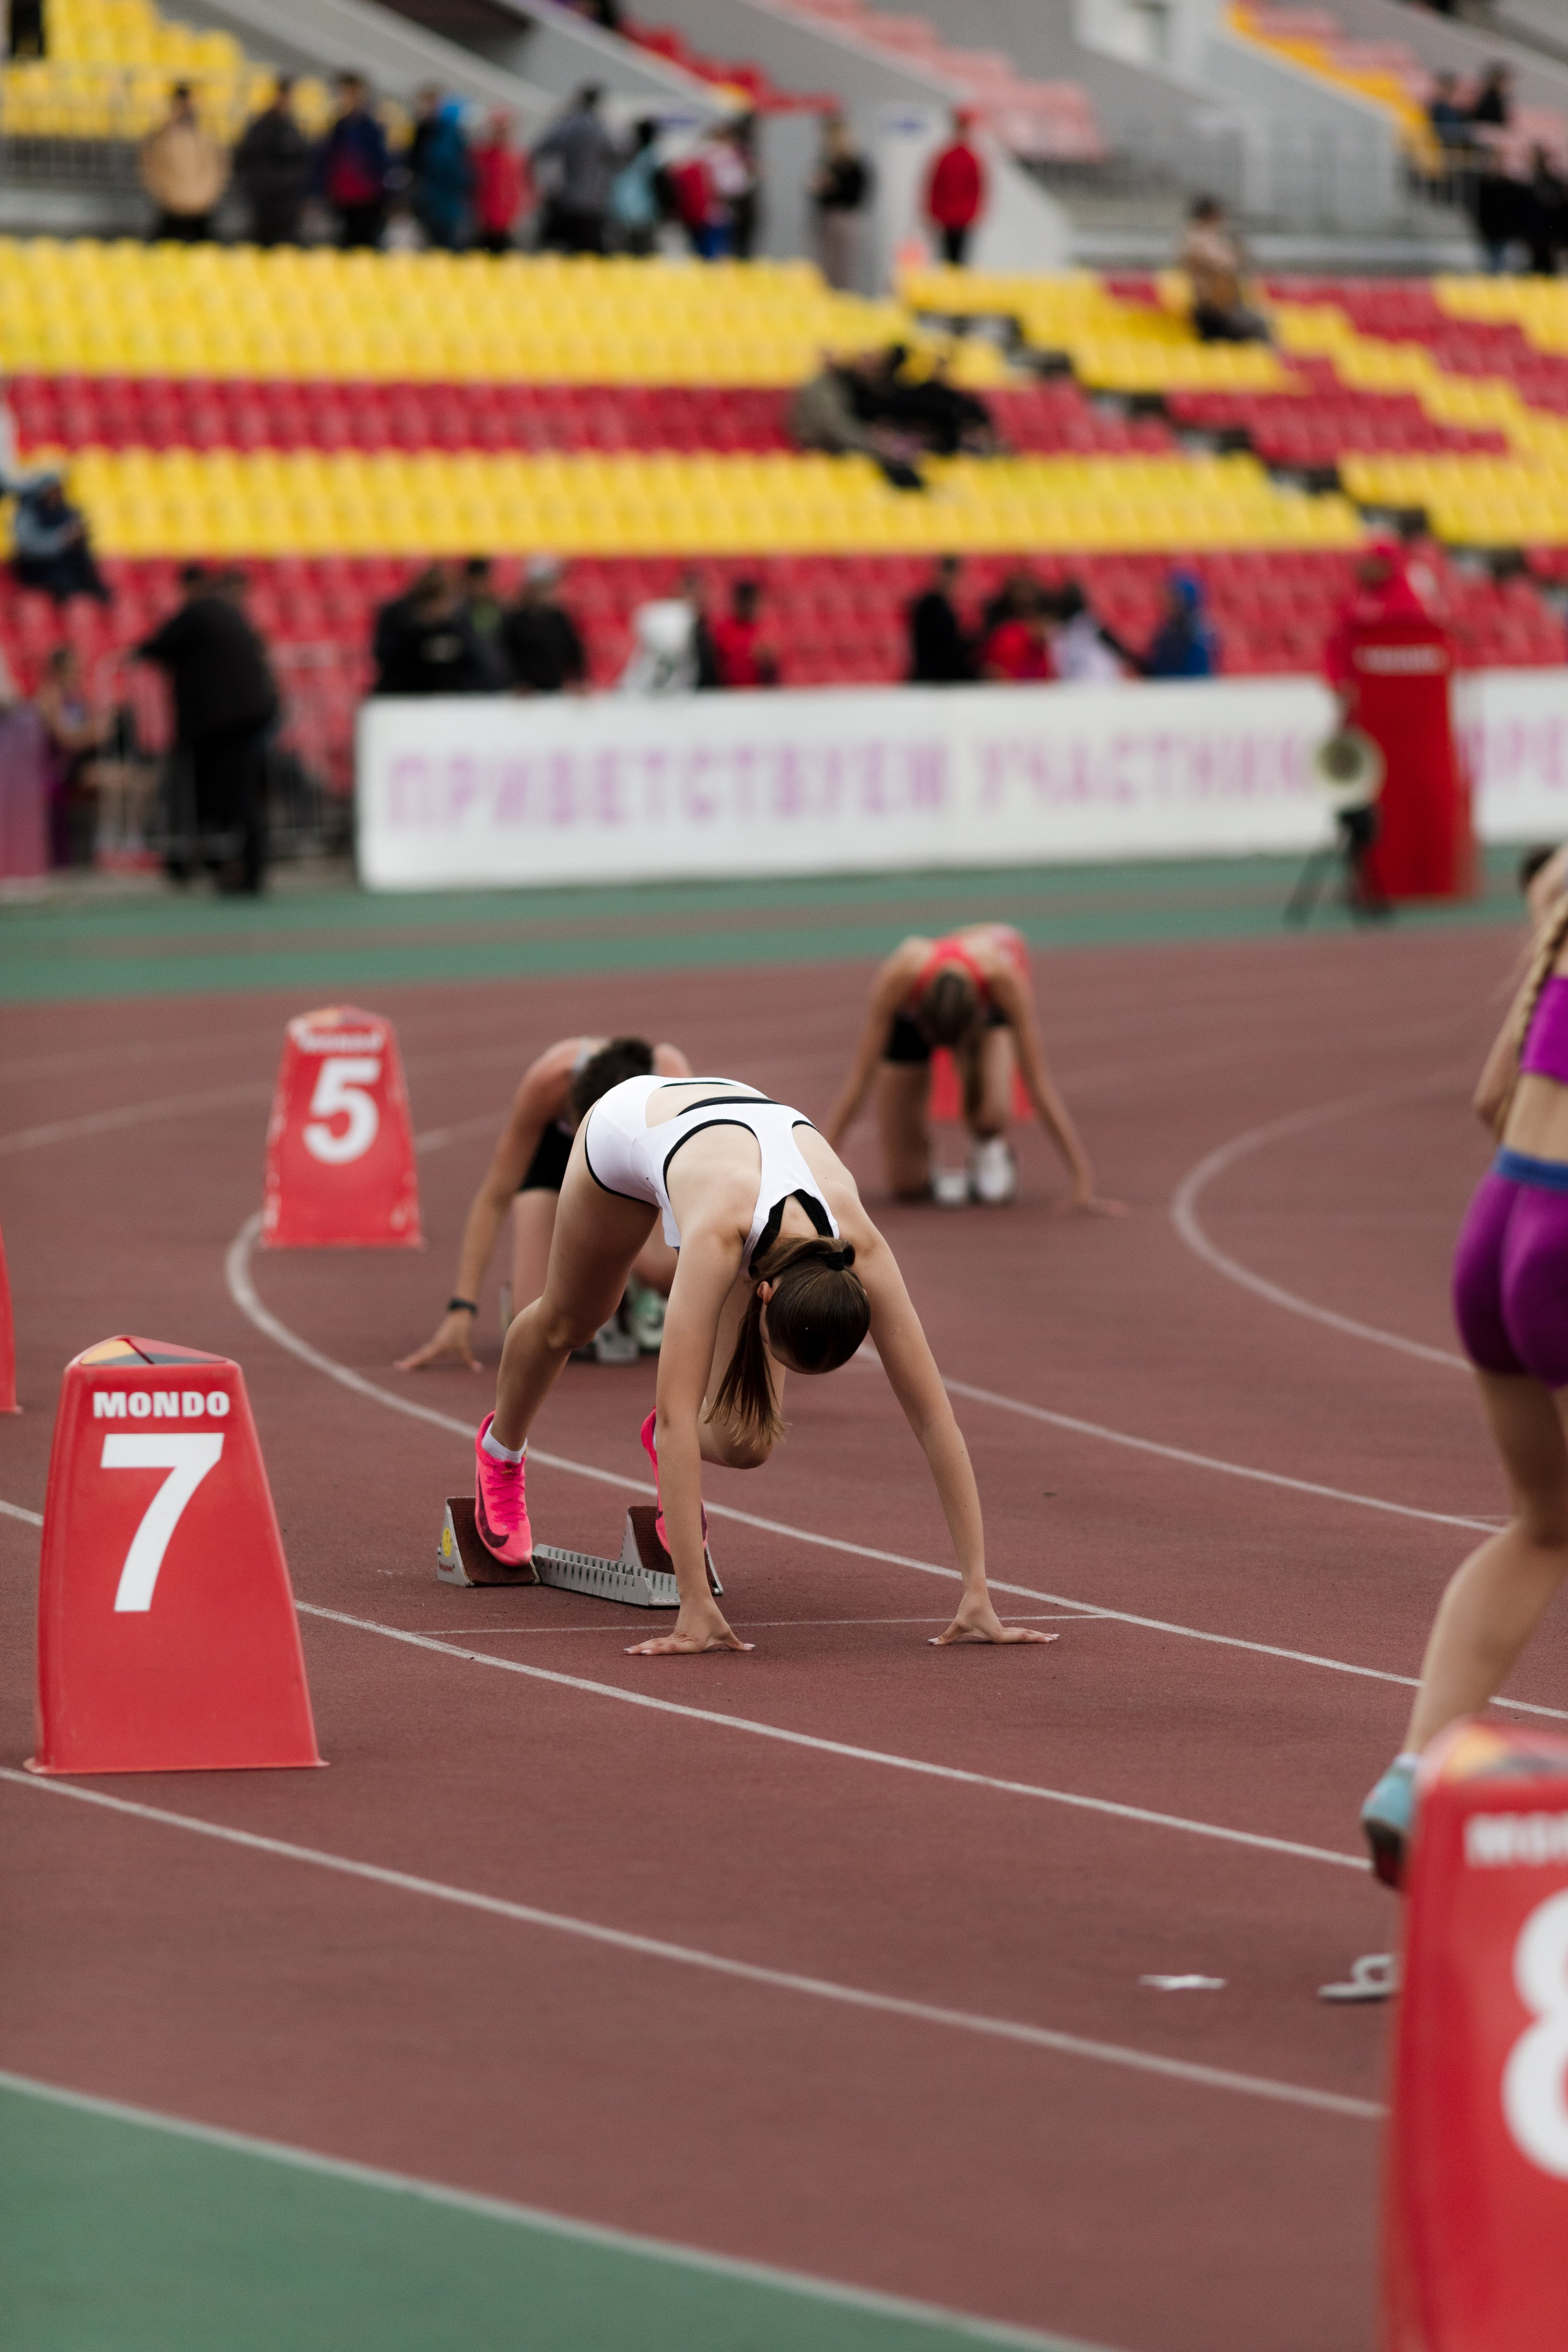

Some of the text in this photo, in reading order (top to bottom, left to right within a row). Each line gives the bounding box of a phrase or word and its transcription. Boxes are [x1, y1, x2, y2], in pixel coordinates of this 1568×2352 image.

[303, 1058, 381, 1164] 5
[93, 1390, 230, 1419] MONDO
[100, 1433, 225, 1612] 7
